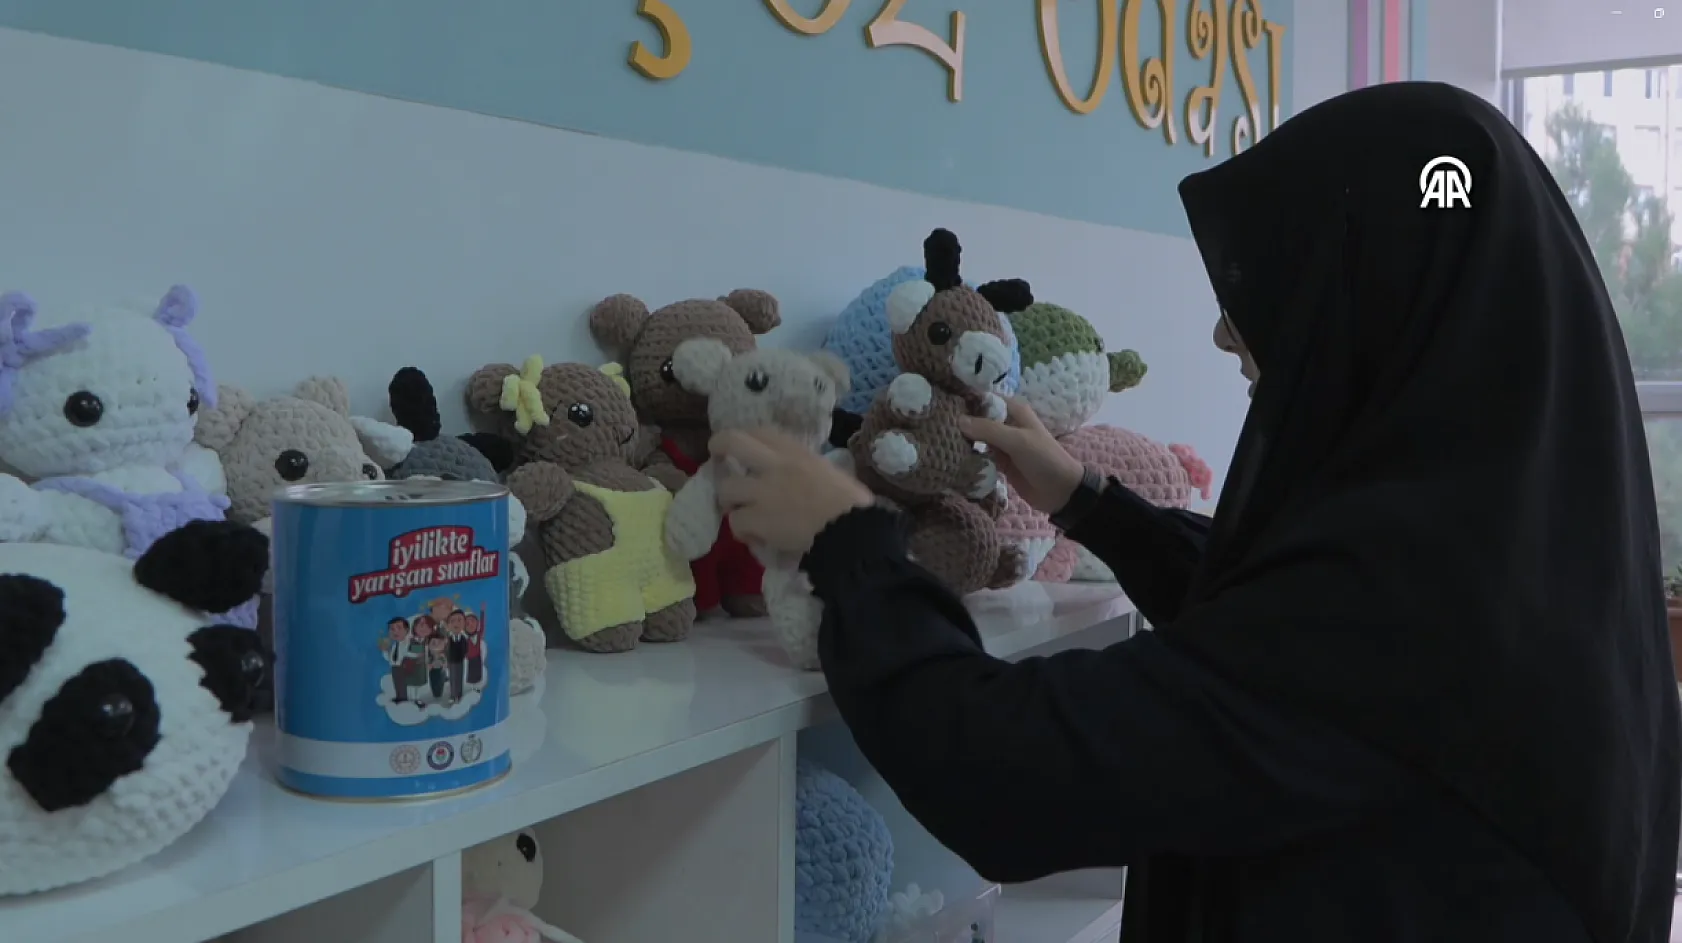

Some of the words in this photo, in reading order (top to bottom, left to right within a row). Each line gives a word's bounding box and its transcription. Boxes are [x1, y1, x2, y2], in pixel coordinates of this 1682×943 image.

[392, 529, 469, 570] iyilikte
[351, 567, 433, 601] yarışan
[436, 549, 496, 582] sınıflar
